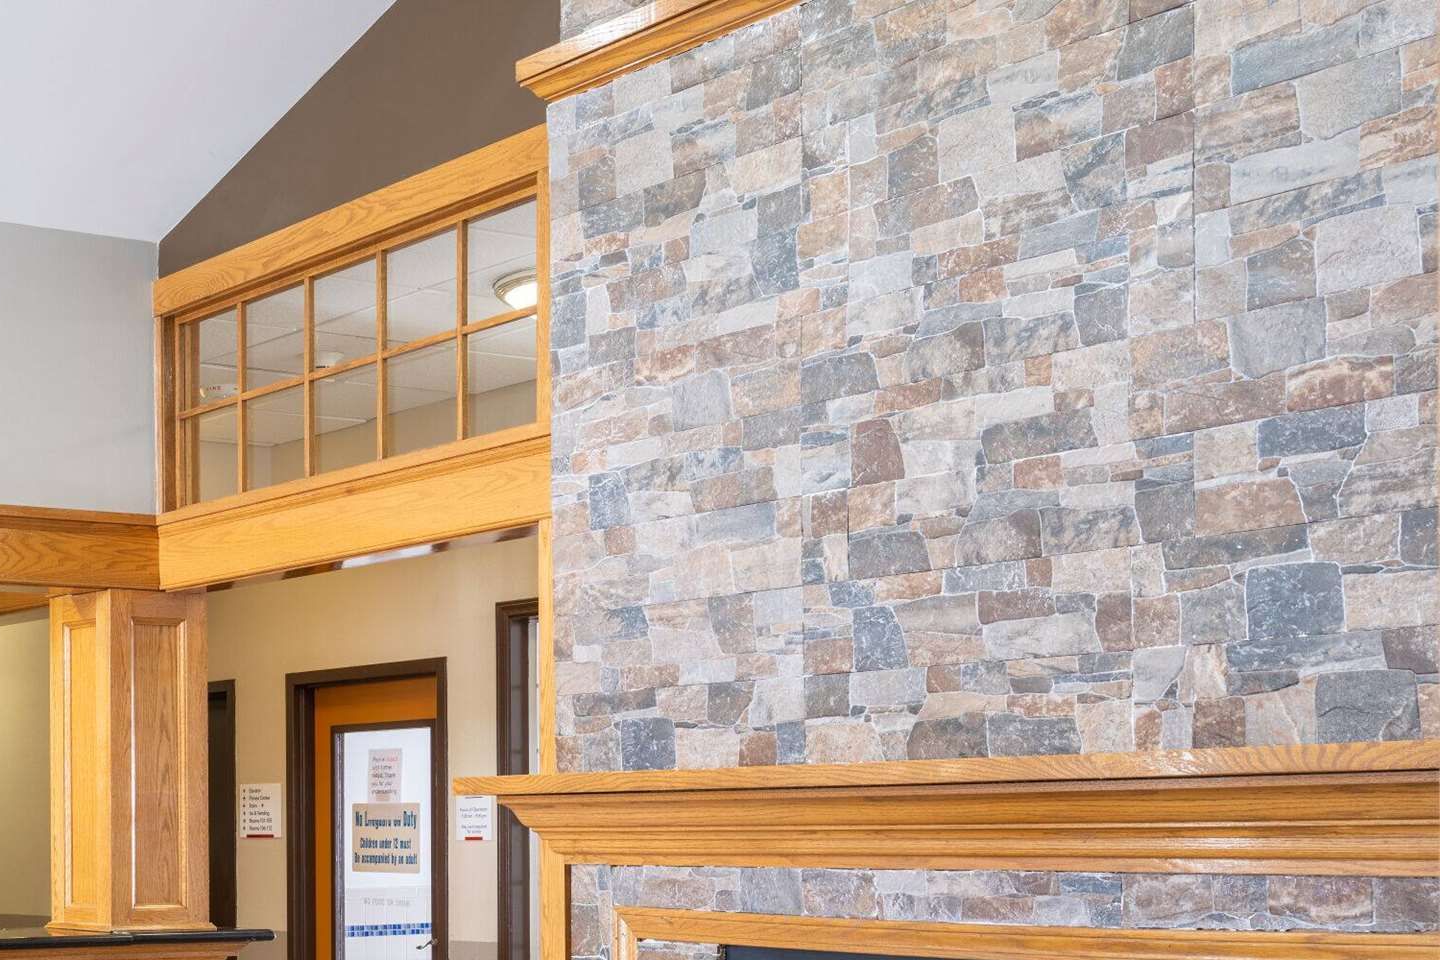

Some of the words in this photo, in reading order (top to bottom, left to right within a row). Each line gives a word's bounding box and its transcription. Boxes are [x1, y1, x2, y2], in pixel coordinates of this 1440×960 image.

[355, 811, 363, 826] No
[403, 810, 417, 829] Duty
[360, 837, 378, 848] Children
[379, 838, 392, 849] under
[400, 838, 411, 849] must
[361, 853, 390, 865] accompanied
[391, 853, 397, 866] by
